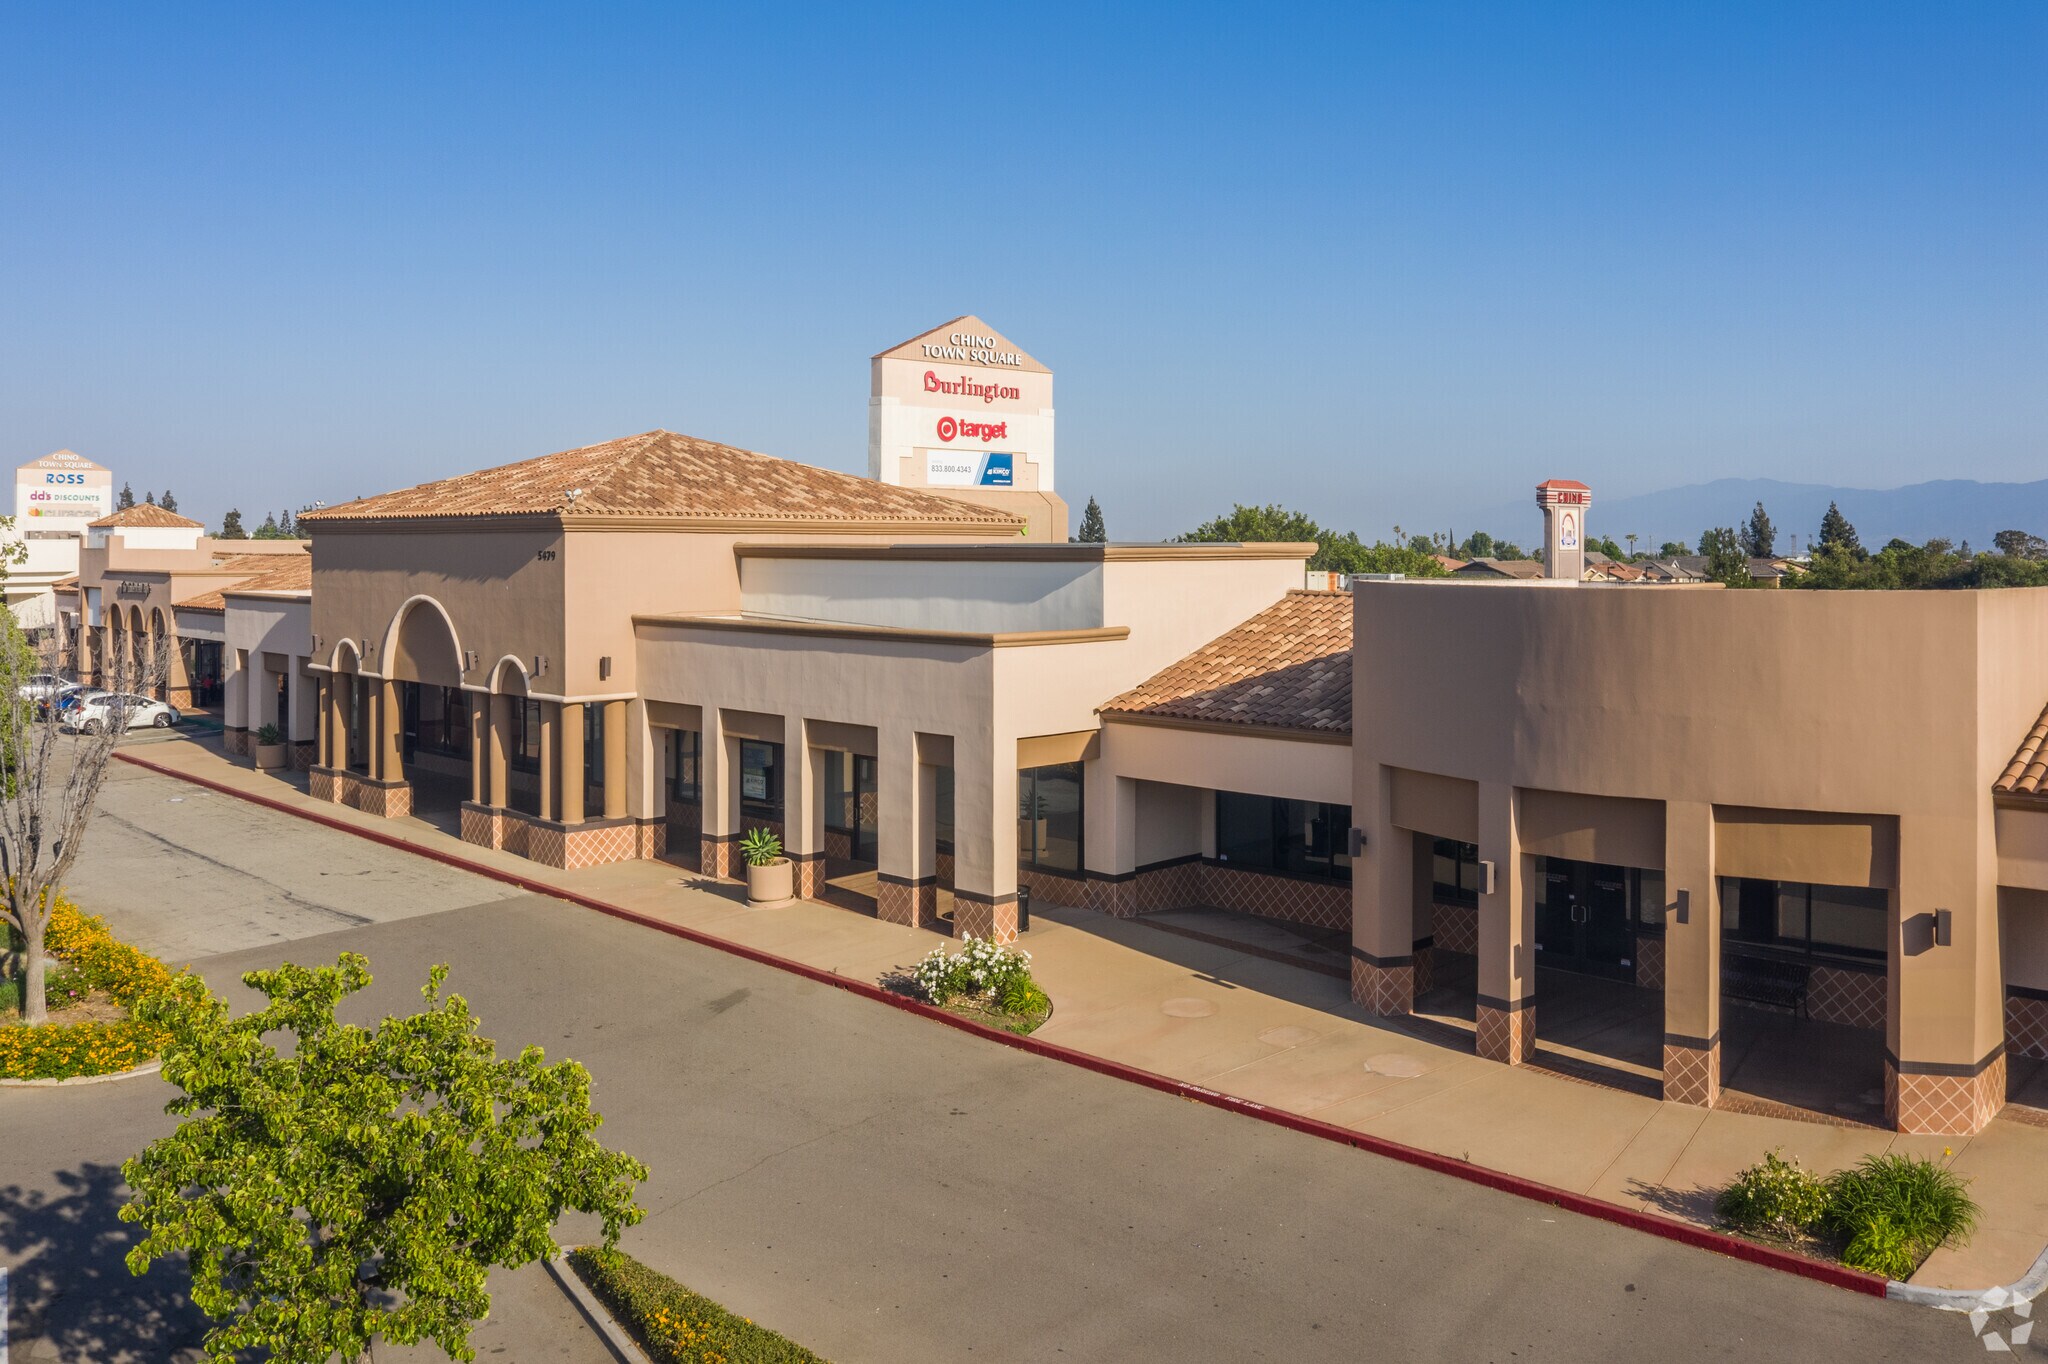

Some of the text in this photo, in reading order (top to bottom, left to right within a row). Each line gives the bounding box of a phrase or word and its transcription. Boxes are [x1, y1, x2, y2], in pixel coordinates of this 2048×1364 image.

[950, 333, 997, 349] CHINO
[922, 344, 1022, 366] TOWN SQUARE
[924, 370, 1020, 404] Burlington
[959, 418, 1007, 442] target
[52, 453, 79, 461] CHINO
[39, 460, 93, 470] TOWN SQUARE
[931, 464, 972, 474] 833.800.4343
[46, 473, 84, 484] ROSS
[54, 494, 100, 502] DISCOUNTS
[1558, 492, 1583, 504] CHINO
[537, 550, 556, 561] 5479
